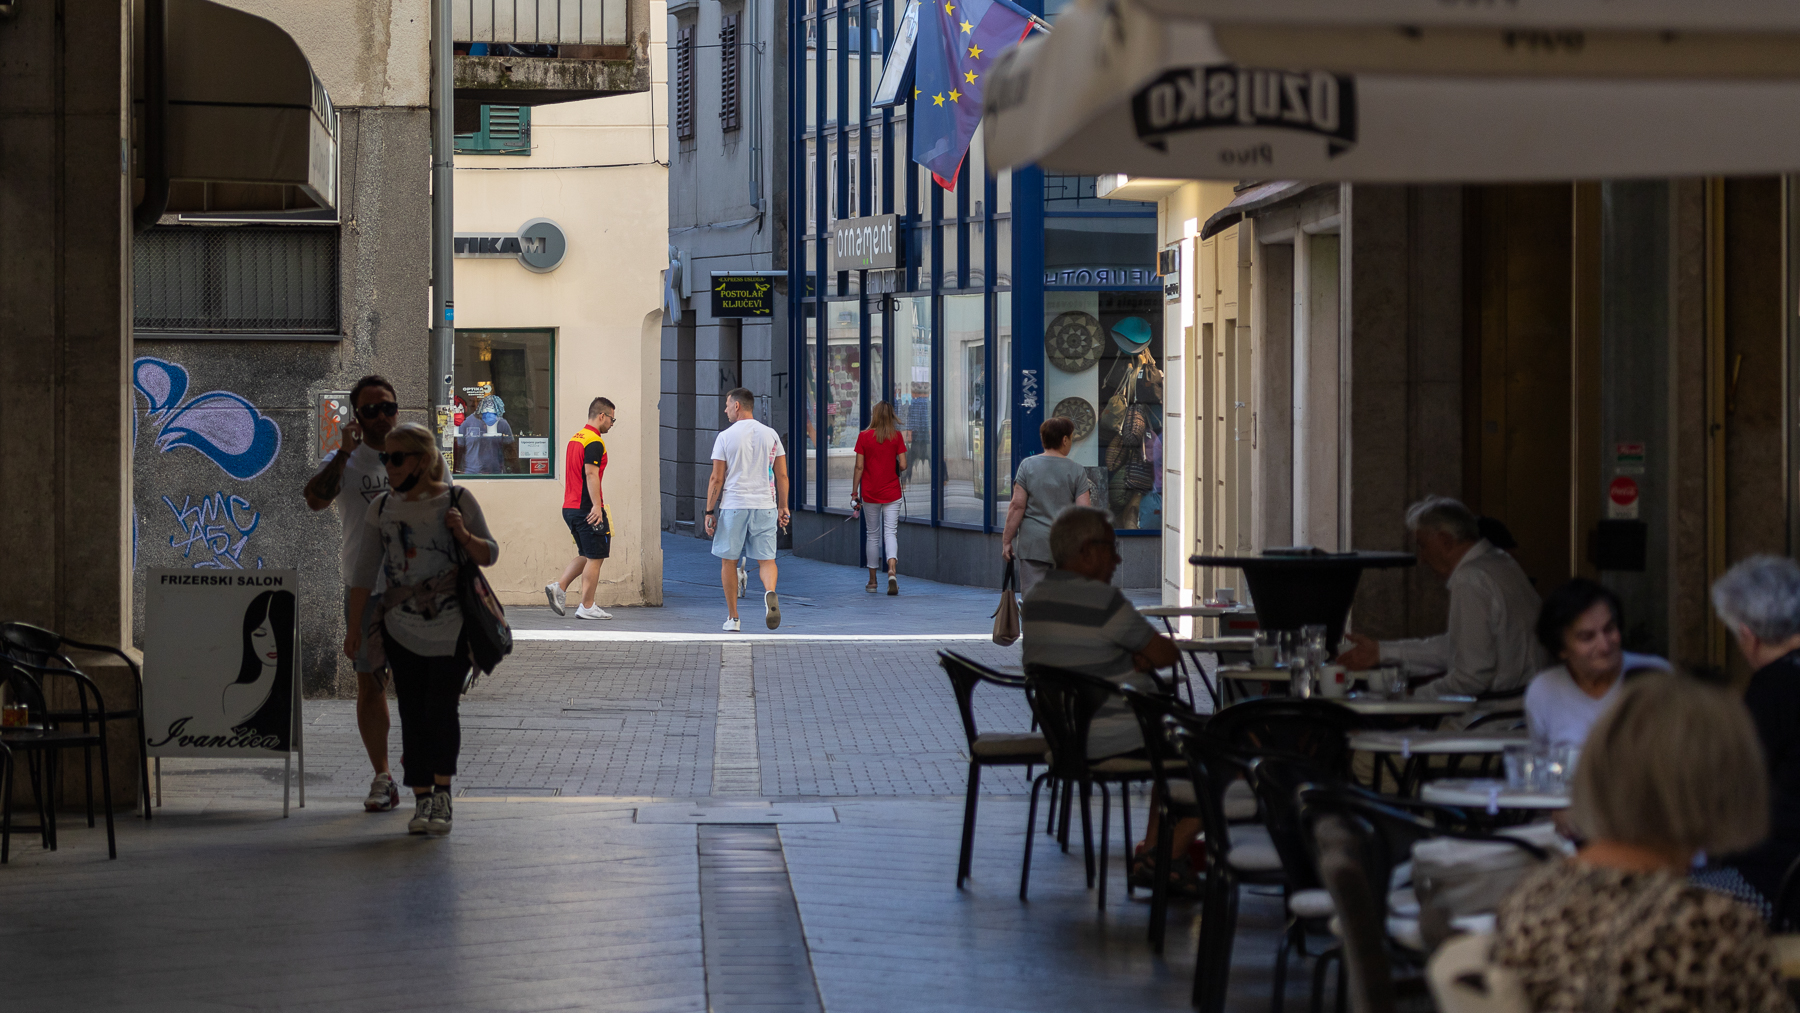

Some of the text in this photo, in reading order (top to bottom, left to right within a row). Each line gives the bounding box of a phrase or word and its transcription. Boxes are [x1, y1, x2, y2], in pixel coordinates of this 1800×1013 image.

[454, 237, 522, 254] TIKA
[837, 218, 893, 264] ornament
[720, 290, 764, 298] POSTOLAR
[722, 299, 762, 308] KLJUČEVI
[162, 491, 261, 535] KMC
[161, 575, 283, 587] FRIZERSKI SALON
[147, 716, 281, 749] Ivančica
